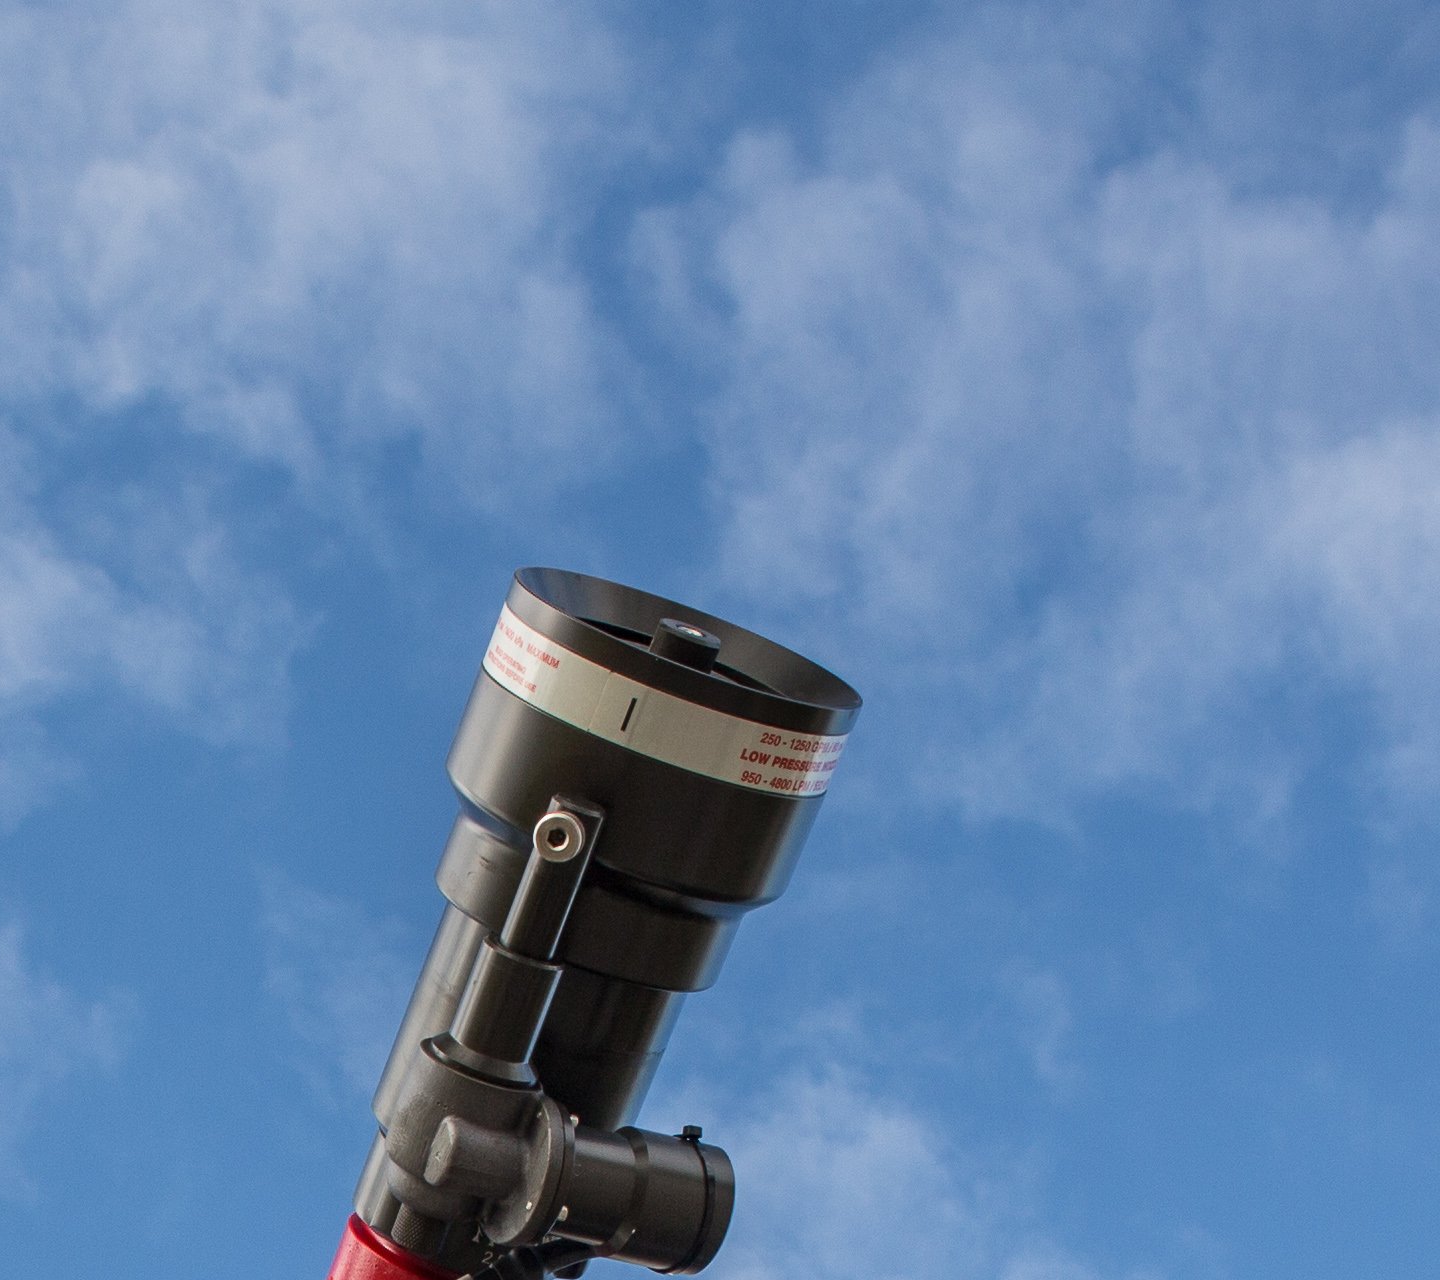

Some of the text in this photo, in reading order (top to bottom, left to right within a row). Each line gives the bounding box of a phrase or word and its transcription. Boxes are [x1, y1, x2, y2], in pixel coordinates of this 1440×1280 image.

[527, 643, 560, 669] MAXIMUM
[760, 732, 781, 747] 250
[790, 738, 812, 752] 1250
[740, 748, 771, 765] LOW
[771, 756, 823, 773] PRESSURE
[741, 770, 762, 785] 950
[769, 776, 792, 791] 4800
